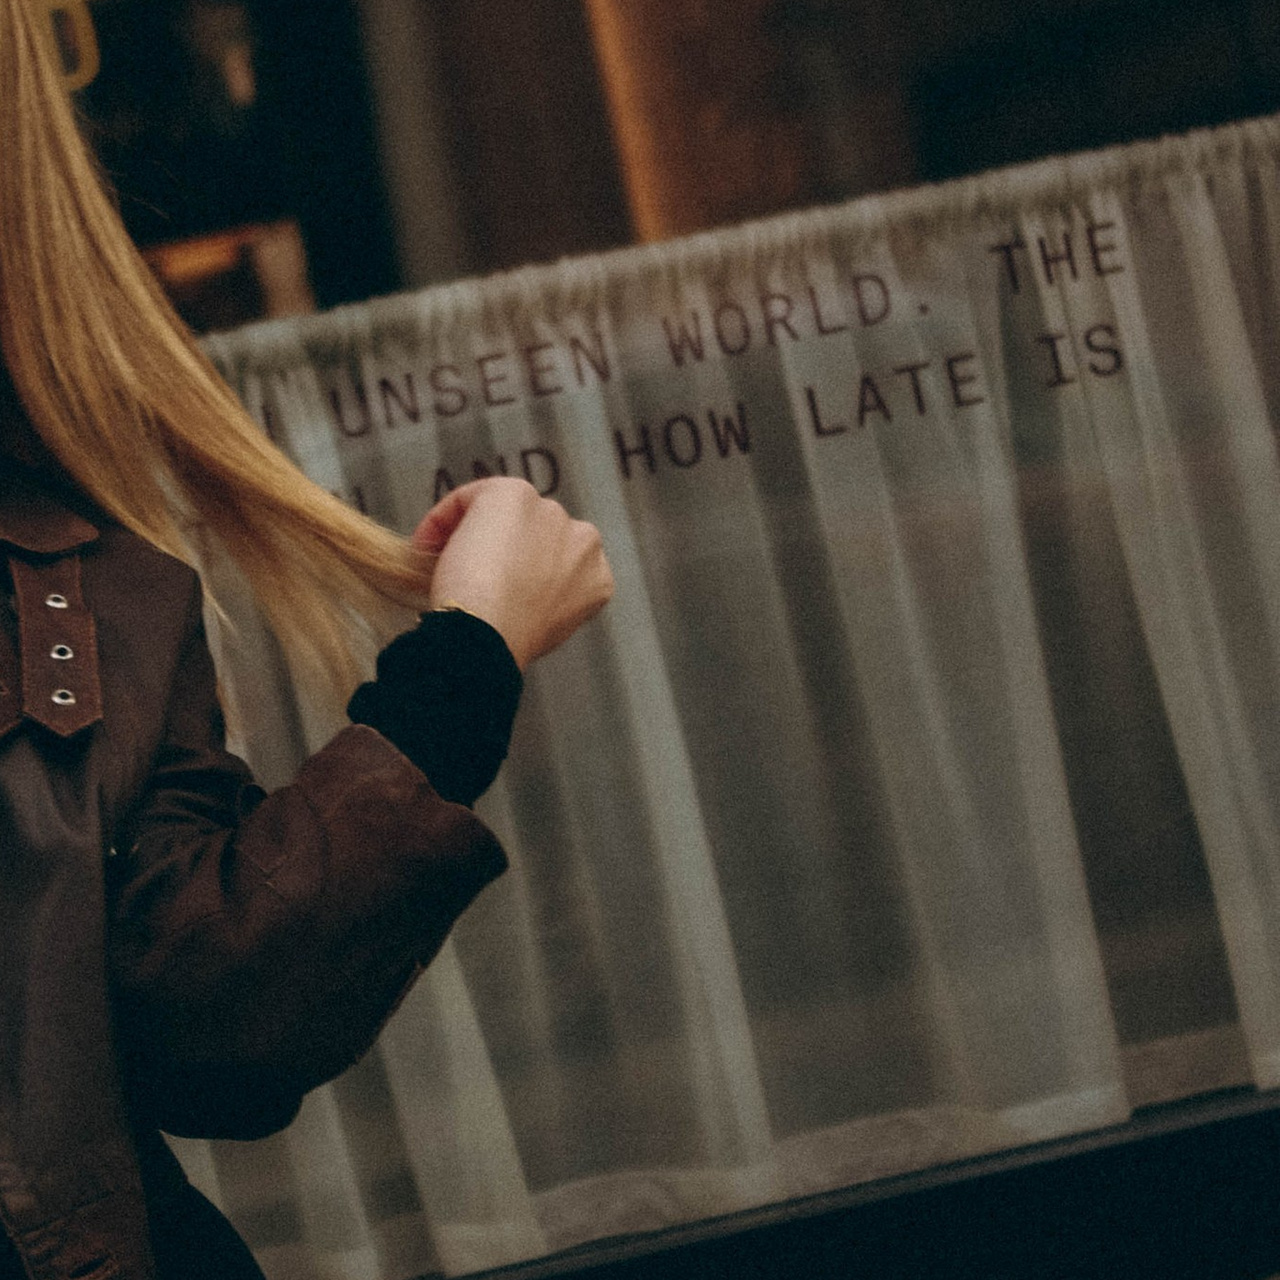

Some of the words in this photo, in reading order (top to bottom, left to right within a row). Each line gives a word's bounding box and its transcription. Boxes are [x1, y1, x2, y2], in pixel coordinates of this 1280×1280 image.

[328, 333, 612, 438] UNSEEN
[662, 273, 930, 368] WORLD.
[990, 222, 1124, 289] THE
[434, 447, 560, 503] AD
[615, 402, 751, 478] HOW
[805, 352, 984, 438] LATE
[1036, 324, 1124, 389] IS
